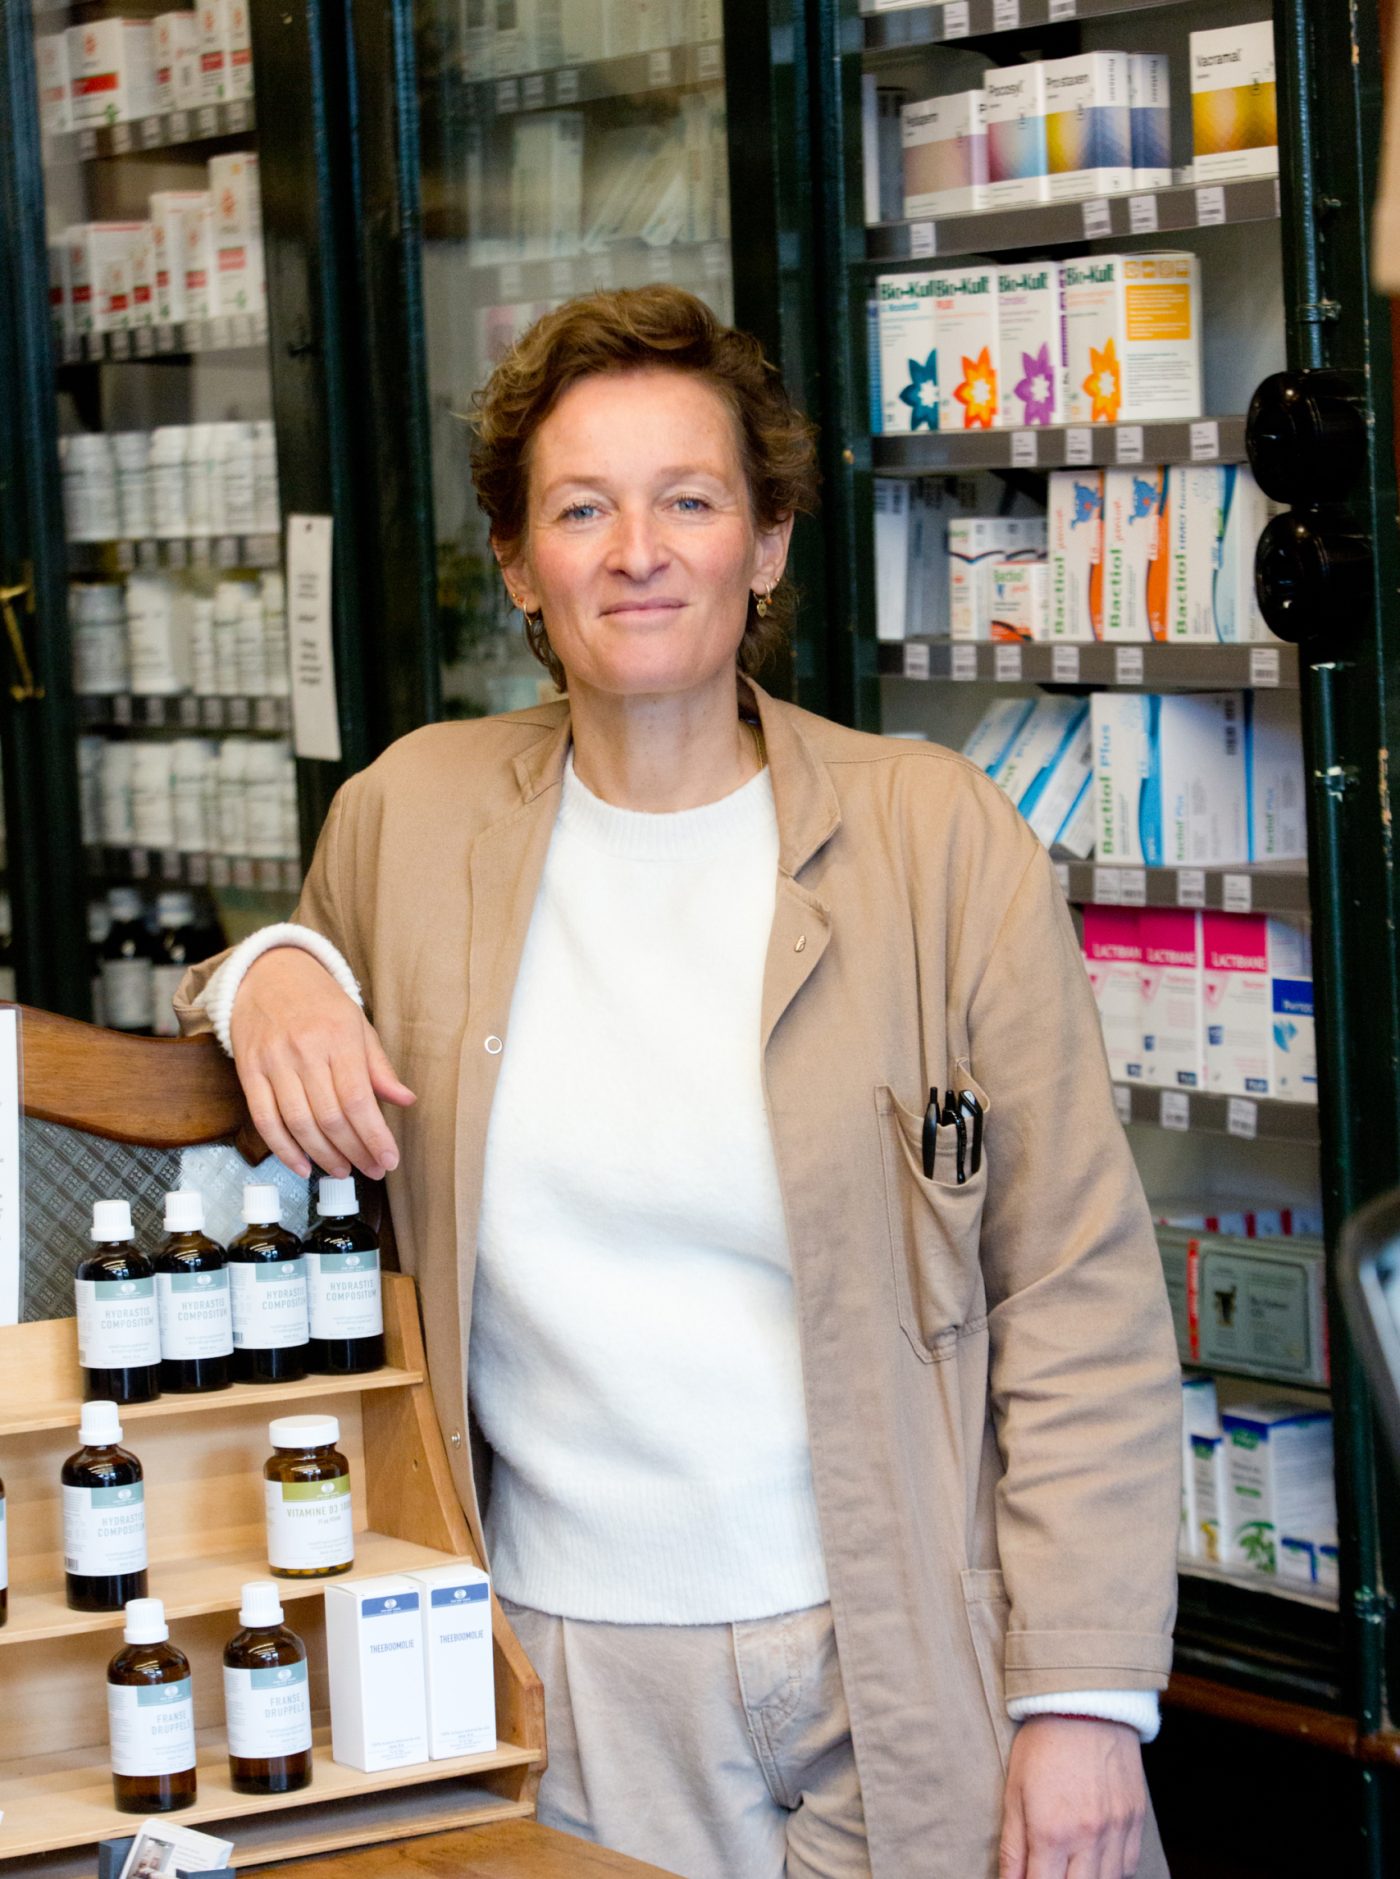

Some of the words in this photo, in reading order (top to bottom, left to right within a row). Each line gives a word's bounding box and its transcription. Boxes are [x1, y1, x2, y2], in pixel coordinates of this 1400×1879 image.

[998, 272, 1048, 293] Bio-Kult
[1065, 264, 1115, 287] Bio-Kult
[935, 276, 990, 298] Bio-Kult
[1054, 557, 1065, 634] Bactiol
[1110, 549, 1121, 628] Bactiol
[1174, 554, 1186, 634] Bactiol
[1100, 724, 1111, 768] Plus
[1100, 776, 1113, 855] Bactiol
[1092, 943, 1142, 960] LACTIBIAN
[330, 1279, 374, 1291] HYDRASTIS
[326, 1289, 377, 1302] COMPOSITUM
[182, 1298, 225, 1311] HYDRASTIS
[105, 1306, 151, 1320] HYDRASTIS
[177, 1308, 228, 1321] COMPOSITUM
[101, 1317, 154, 1330] COMPOSITUM
[286, 1507, 328, 1518] VITAMINE
[439, 1629, 484, 1645] THEEBOOMOLIE
[369, 1639, 415, 1655] THEEBOOMOLIE
[269, 1692, 301, 1707] FRANSE
[156, 1709, 187, 1724] FRANSE
[264, 1702, 305, 1719] DRUPPELS
[151, 1719, 191, 1737] DRUPPELS
